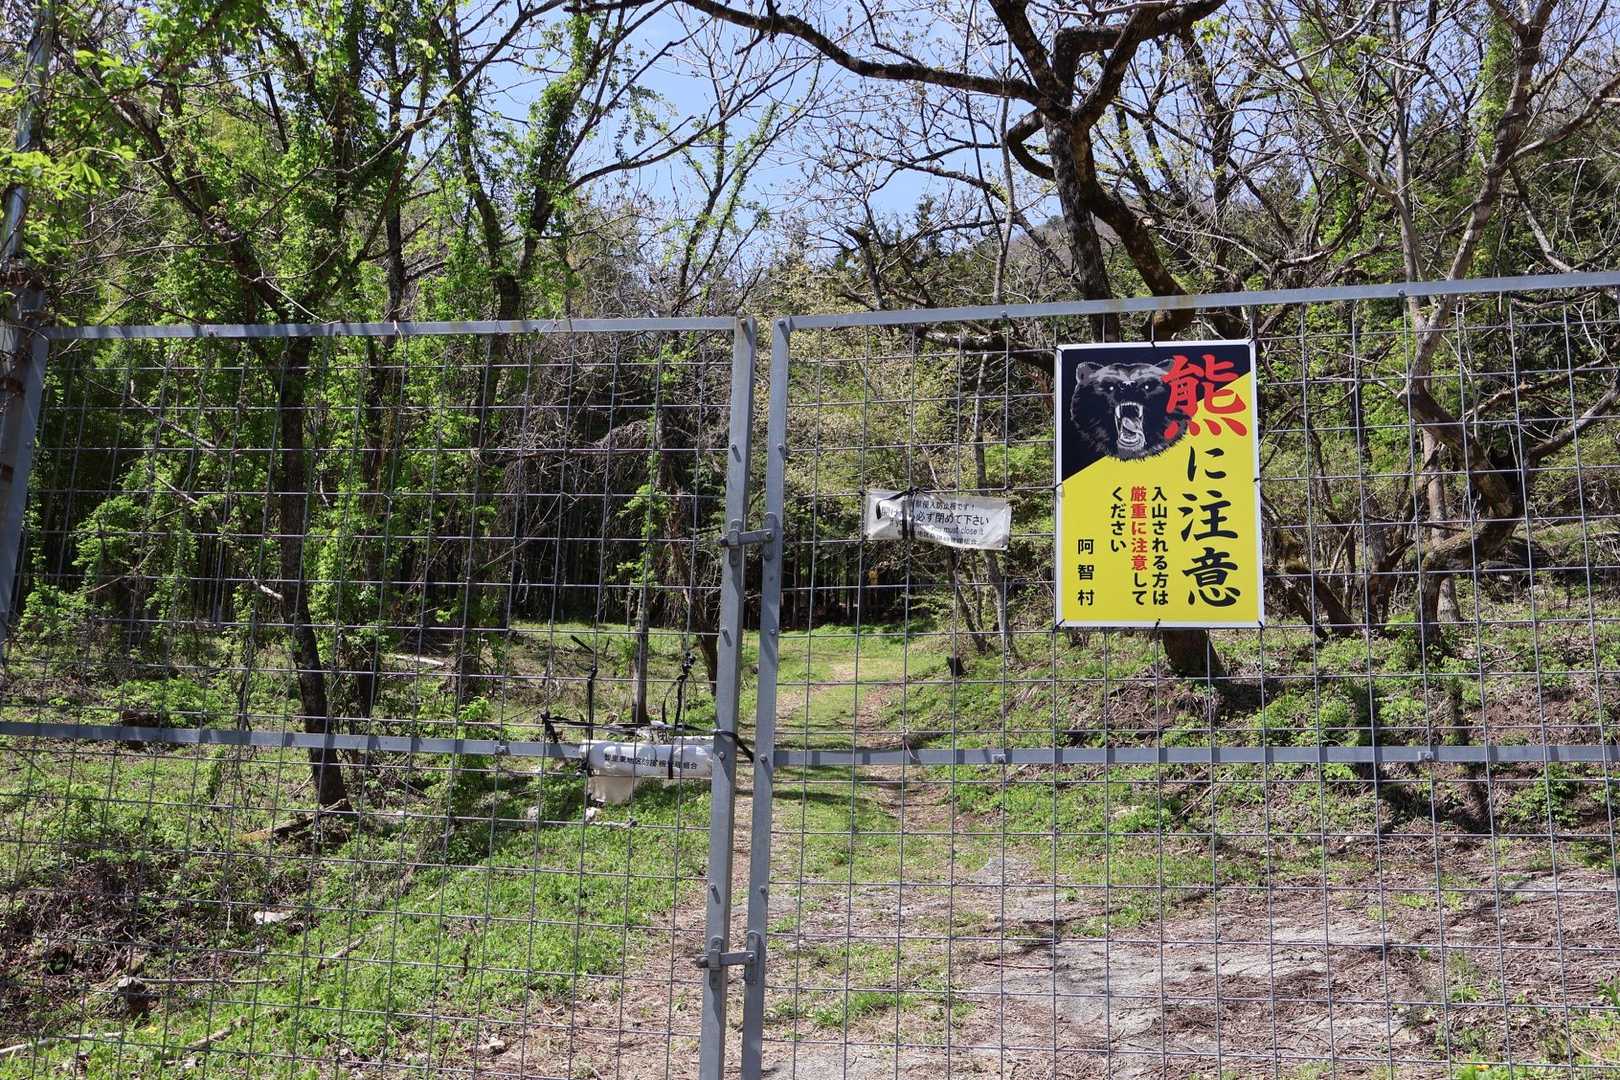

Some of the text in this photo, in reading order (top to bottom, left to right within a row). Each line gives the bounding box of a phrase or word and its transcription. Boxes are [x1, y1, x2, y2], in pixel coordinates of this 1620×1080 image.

[1110, 486, 1127, 553] ください
[1161, 353, 1248, 607] 熊に注意
[960, 526, 978, 536] close
[1077, 538, 1095, 606] 阿智村
[1130, 486, 1148, 605] 厳重に注意して
[1151, 486, 1168, 605] 入山される方は
